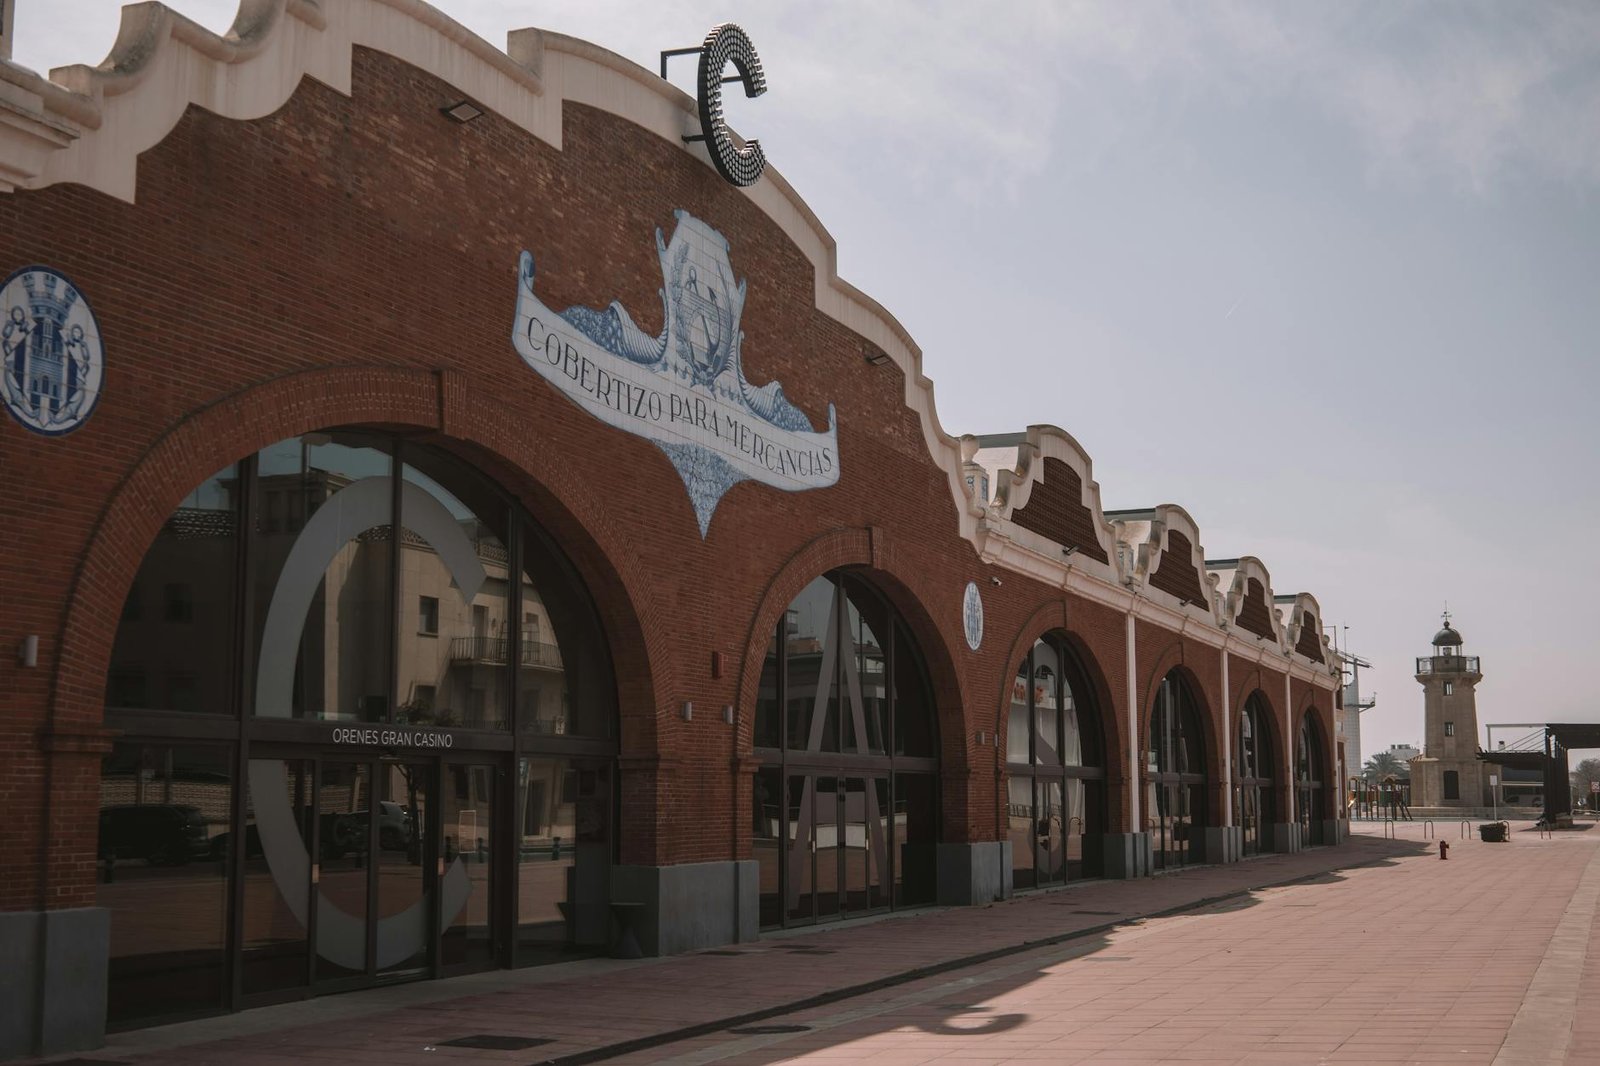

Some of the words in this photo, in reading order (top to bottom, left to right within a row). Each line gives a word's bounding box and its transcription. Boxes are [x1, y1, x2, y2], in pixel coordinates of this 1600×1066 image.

[697, 23, 767, 187] C
[527, 317, 662, 421] COBERTIZO
[670, 393, 720, 437] PARA
[727, 415, 832, 477] MERCANCIAS
[332, 728, 379, 745] ORENES
[381, 730, 412, 746] GRAN
[414, 732, 453, 748] CASINO
